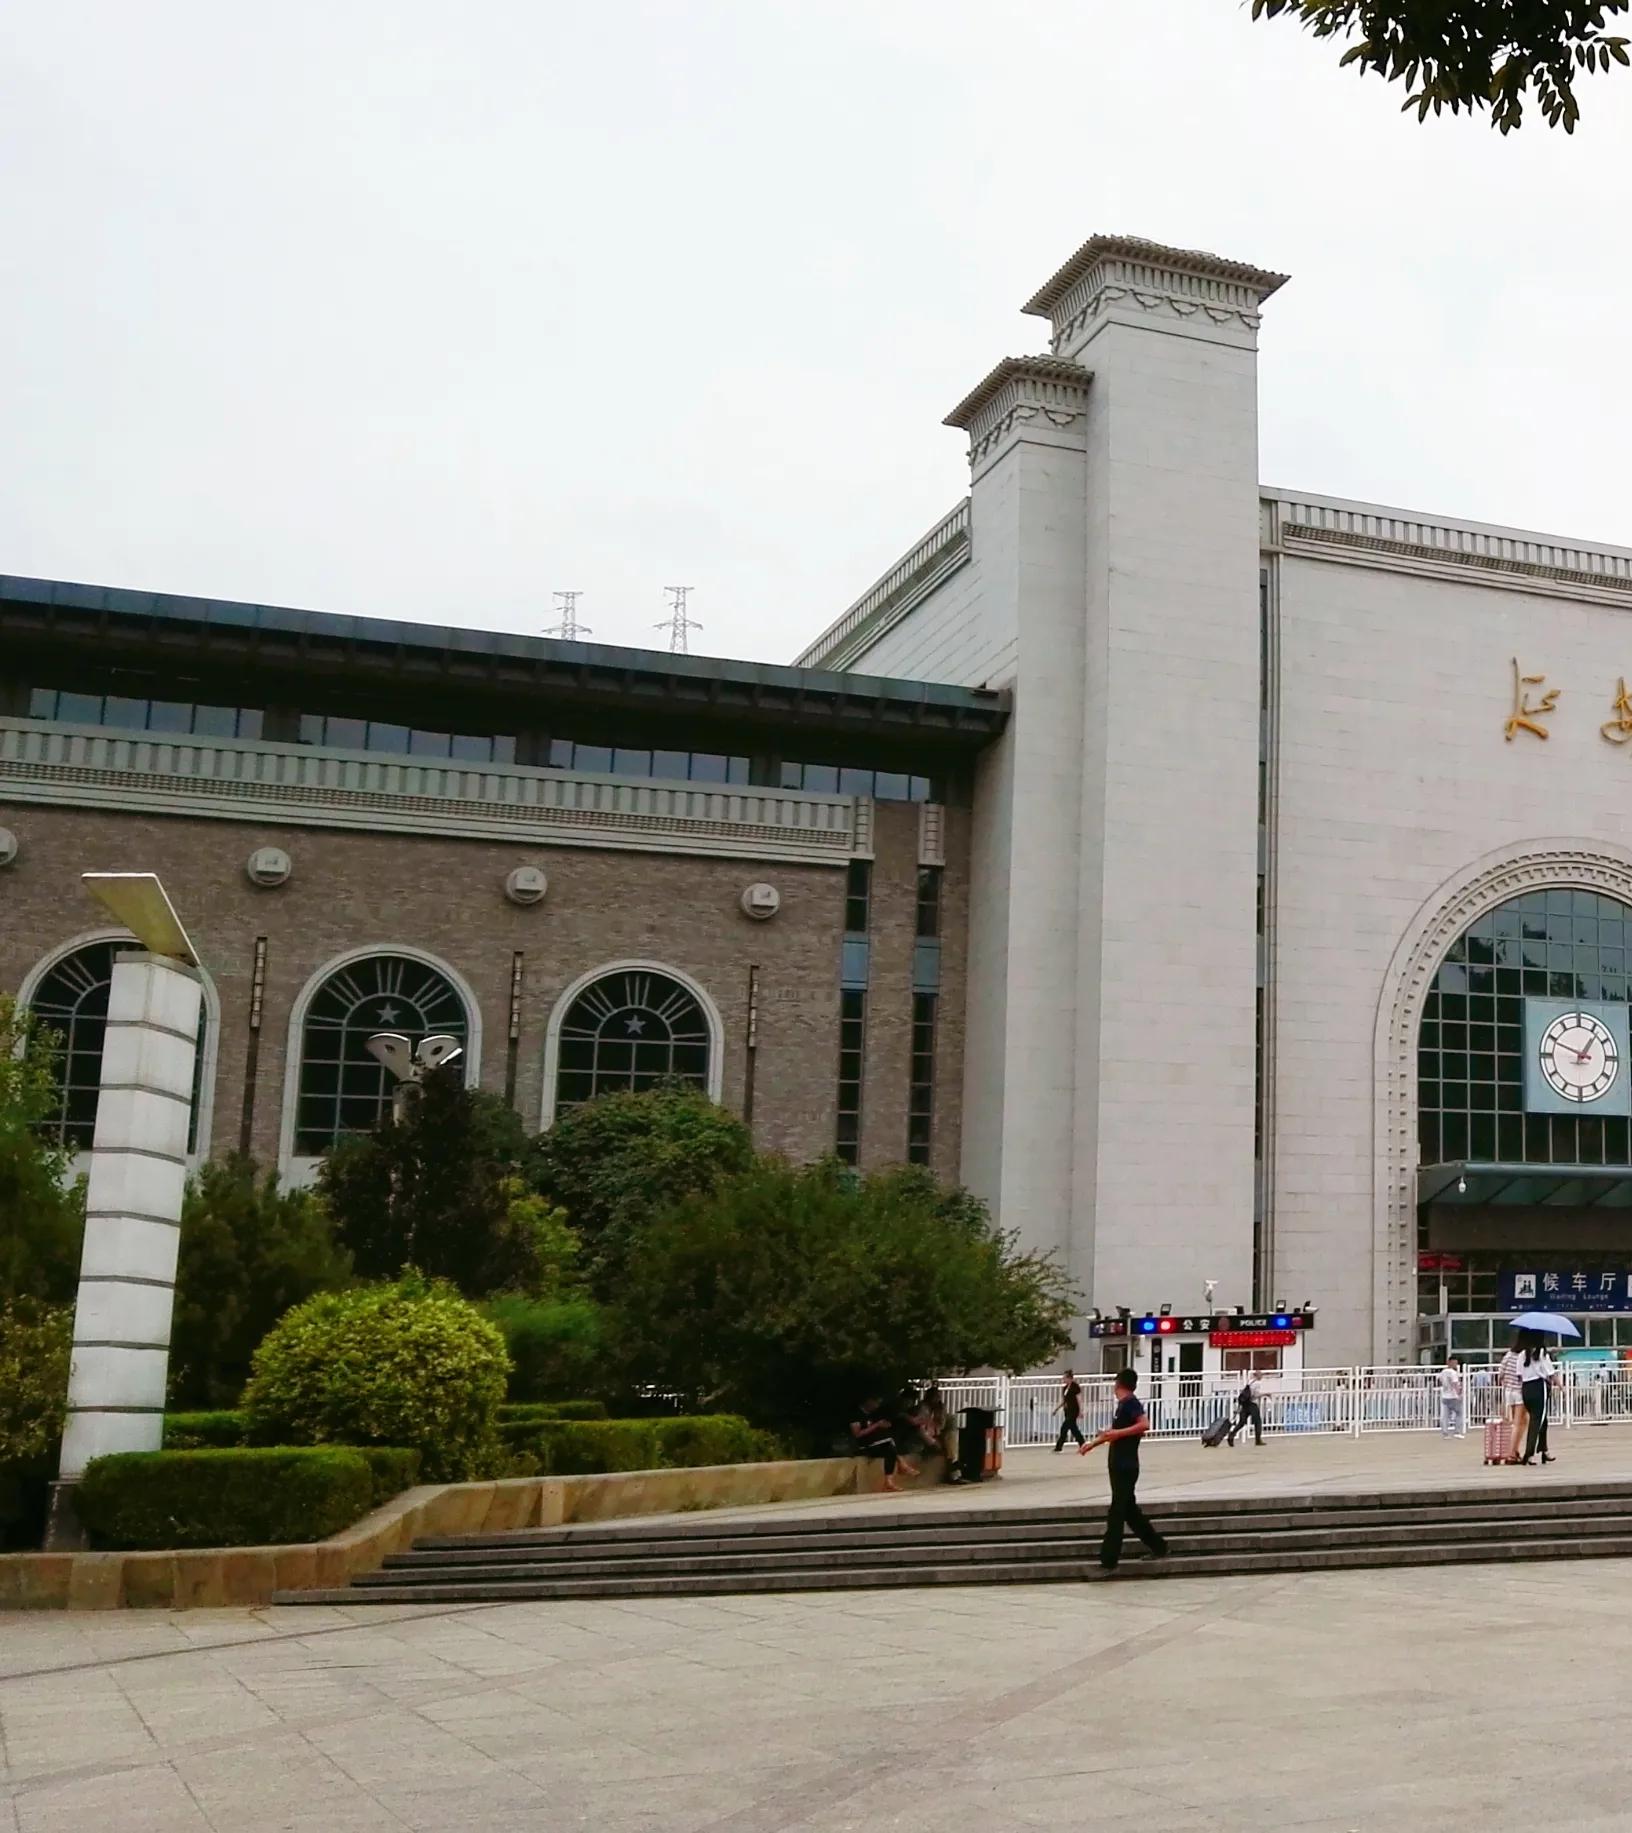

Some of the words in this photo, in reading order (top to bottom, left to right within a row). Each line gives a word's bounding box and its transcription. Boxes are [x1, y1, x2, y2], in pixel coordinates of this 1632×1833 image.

[1542, 1272, 1616, 1291] 候车厅
[1239, 1318, 1267, 1328] POLICE
